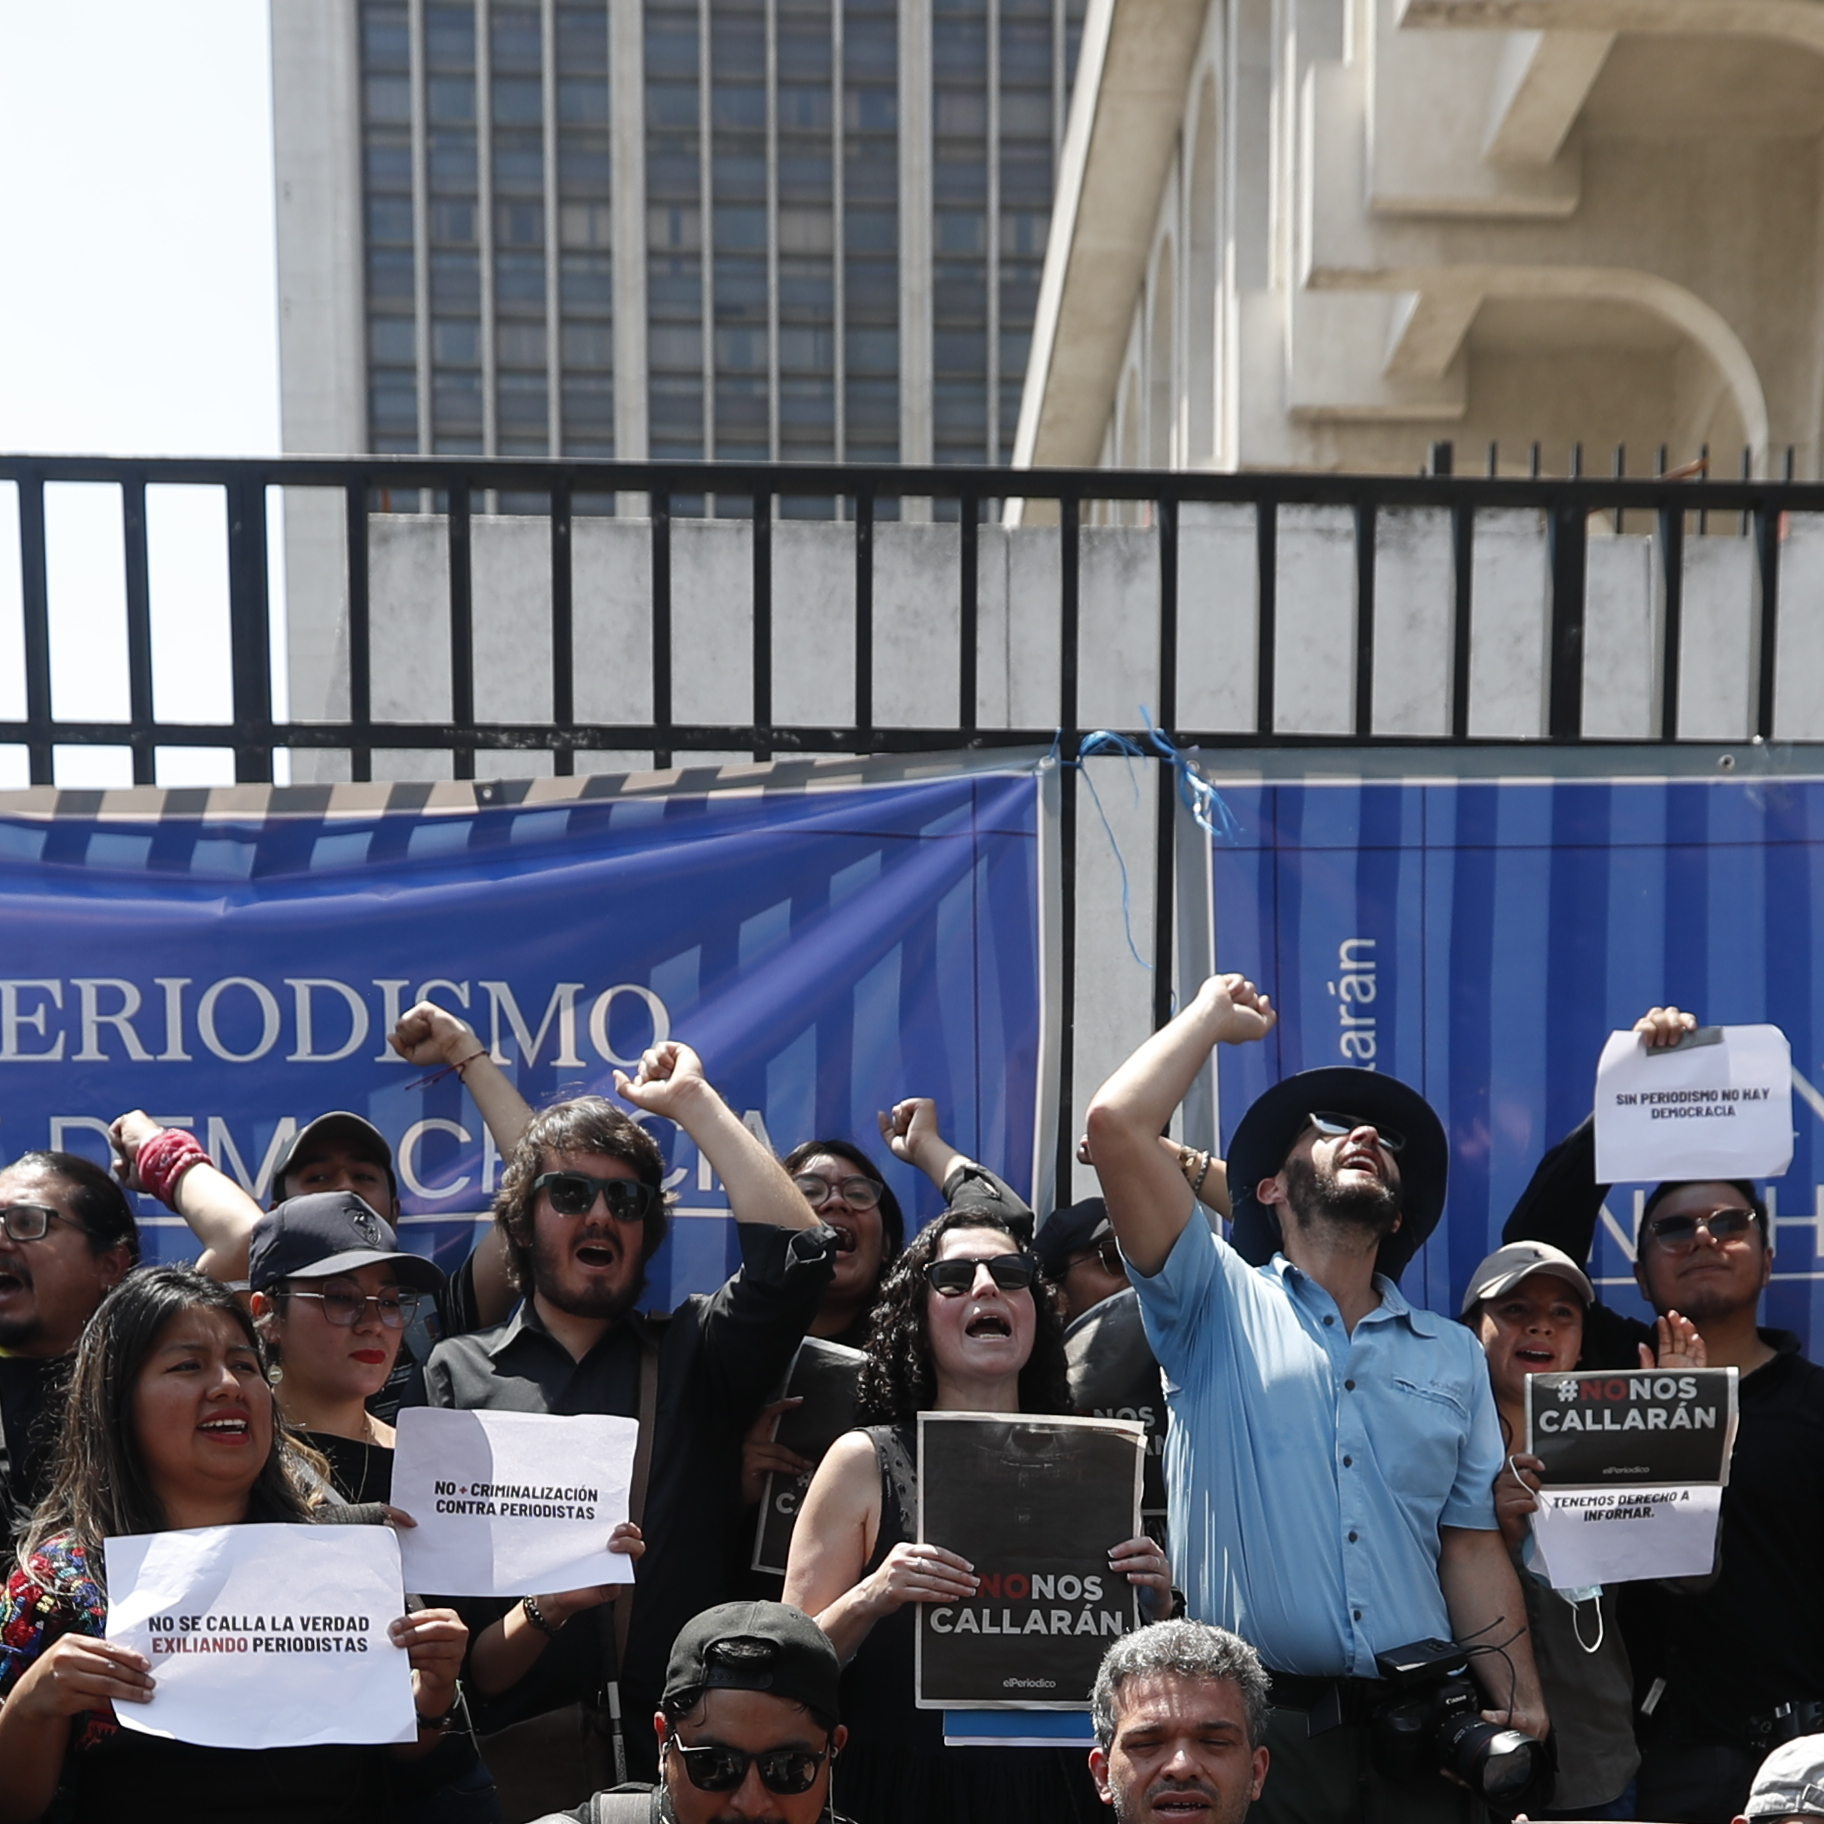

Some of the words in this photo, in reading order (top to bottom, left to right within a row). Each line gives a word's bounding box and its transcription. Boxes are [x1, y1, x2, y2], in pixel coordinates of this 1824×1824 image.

[1616, 1093, 1637, 1106] SIN
[1640, 1090, 1719, 1105] PERIODISMO
[1721, 1089, 1739, 1103] NO
[1742, 1087, 1769, 1101] HAY
[1651, 1105, 1735, 1120] DEMOCRACIA
[1558, 1376, 1698, 1402] #NONOS
[1539, 1403, 1717, 1433] CALLARÁN
[434, 1481, 455, 1495] NO
[470, 1481, 598, 1502] CRIMINALIZACIÓN
[1553, 1495, 1614, 1510] TENEMOS
[1617, 1492, 1677, 1506] DERECHO
[1680, 1490, 1690, 1502] A
[435, 1499, 496, 1515] CONTRA
[500, 1503, 595, 1520] PERIODISTAS
[1583, 1507, 1655, 1523] INFORMAR.
[978, 1573, 1104, 1601] NONOS
[148, 1616, 173, 1632] NO
[179, 1616, 201, 1632] SE
[206, 1616, 266, 1632] CALLA
[271, 1616, 294, 1632] LA
[299, 1616, 370, 1632] VERDAD
[929, 1605, 1124, 1636] CALLARÁN
[152, 1636, 248, 1653] EXILIANDO
[252, 1636, 368, 1653] PERIODISTAS
[1003, 1676, 1056, 1690] elPeriodico
